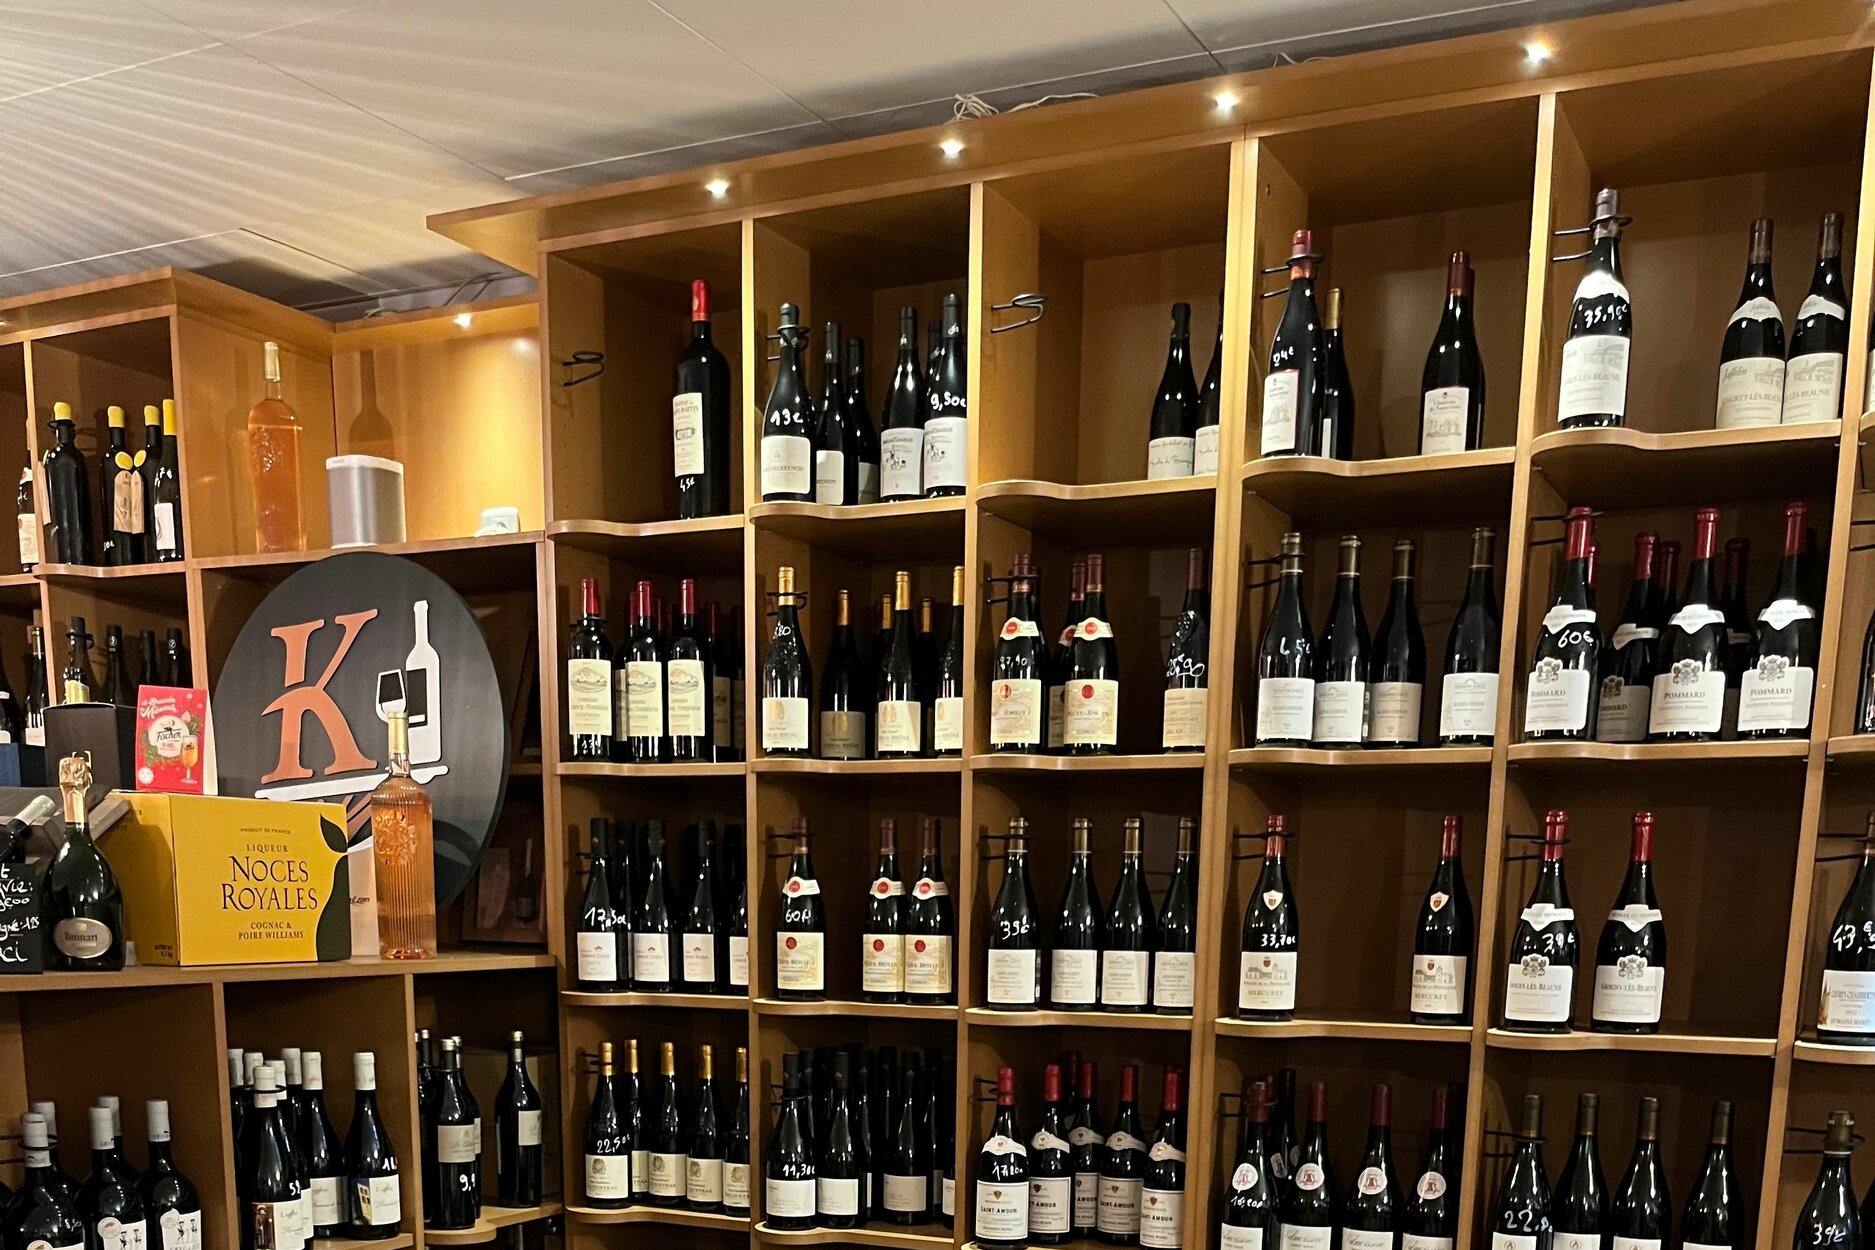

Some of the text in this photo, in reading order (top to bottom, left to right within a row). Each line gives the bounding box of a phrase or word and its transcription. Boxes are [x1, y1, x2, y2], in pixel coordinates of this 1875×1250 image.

[261, 608, 379, 785] K
[1750, 688, 1793, 696] POMMARD
[246, 843, 289, 853] LIQUEUR
[229, 856, 309, 883] NOCES
[221, 883, 318, 911] ROYALES
[250, 921, 285, 930] COGNAC
[238, 931, 304, 940] POIRE WILLIAMS
